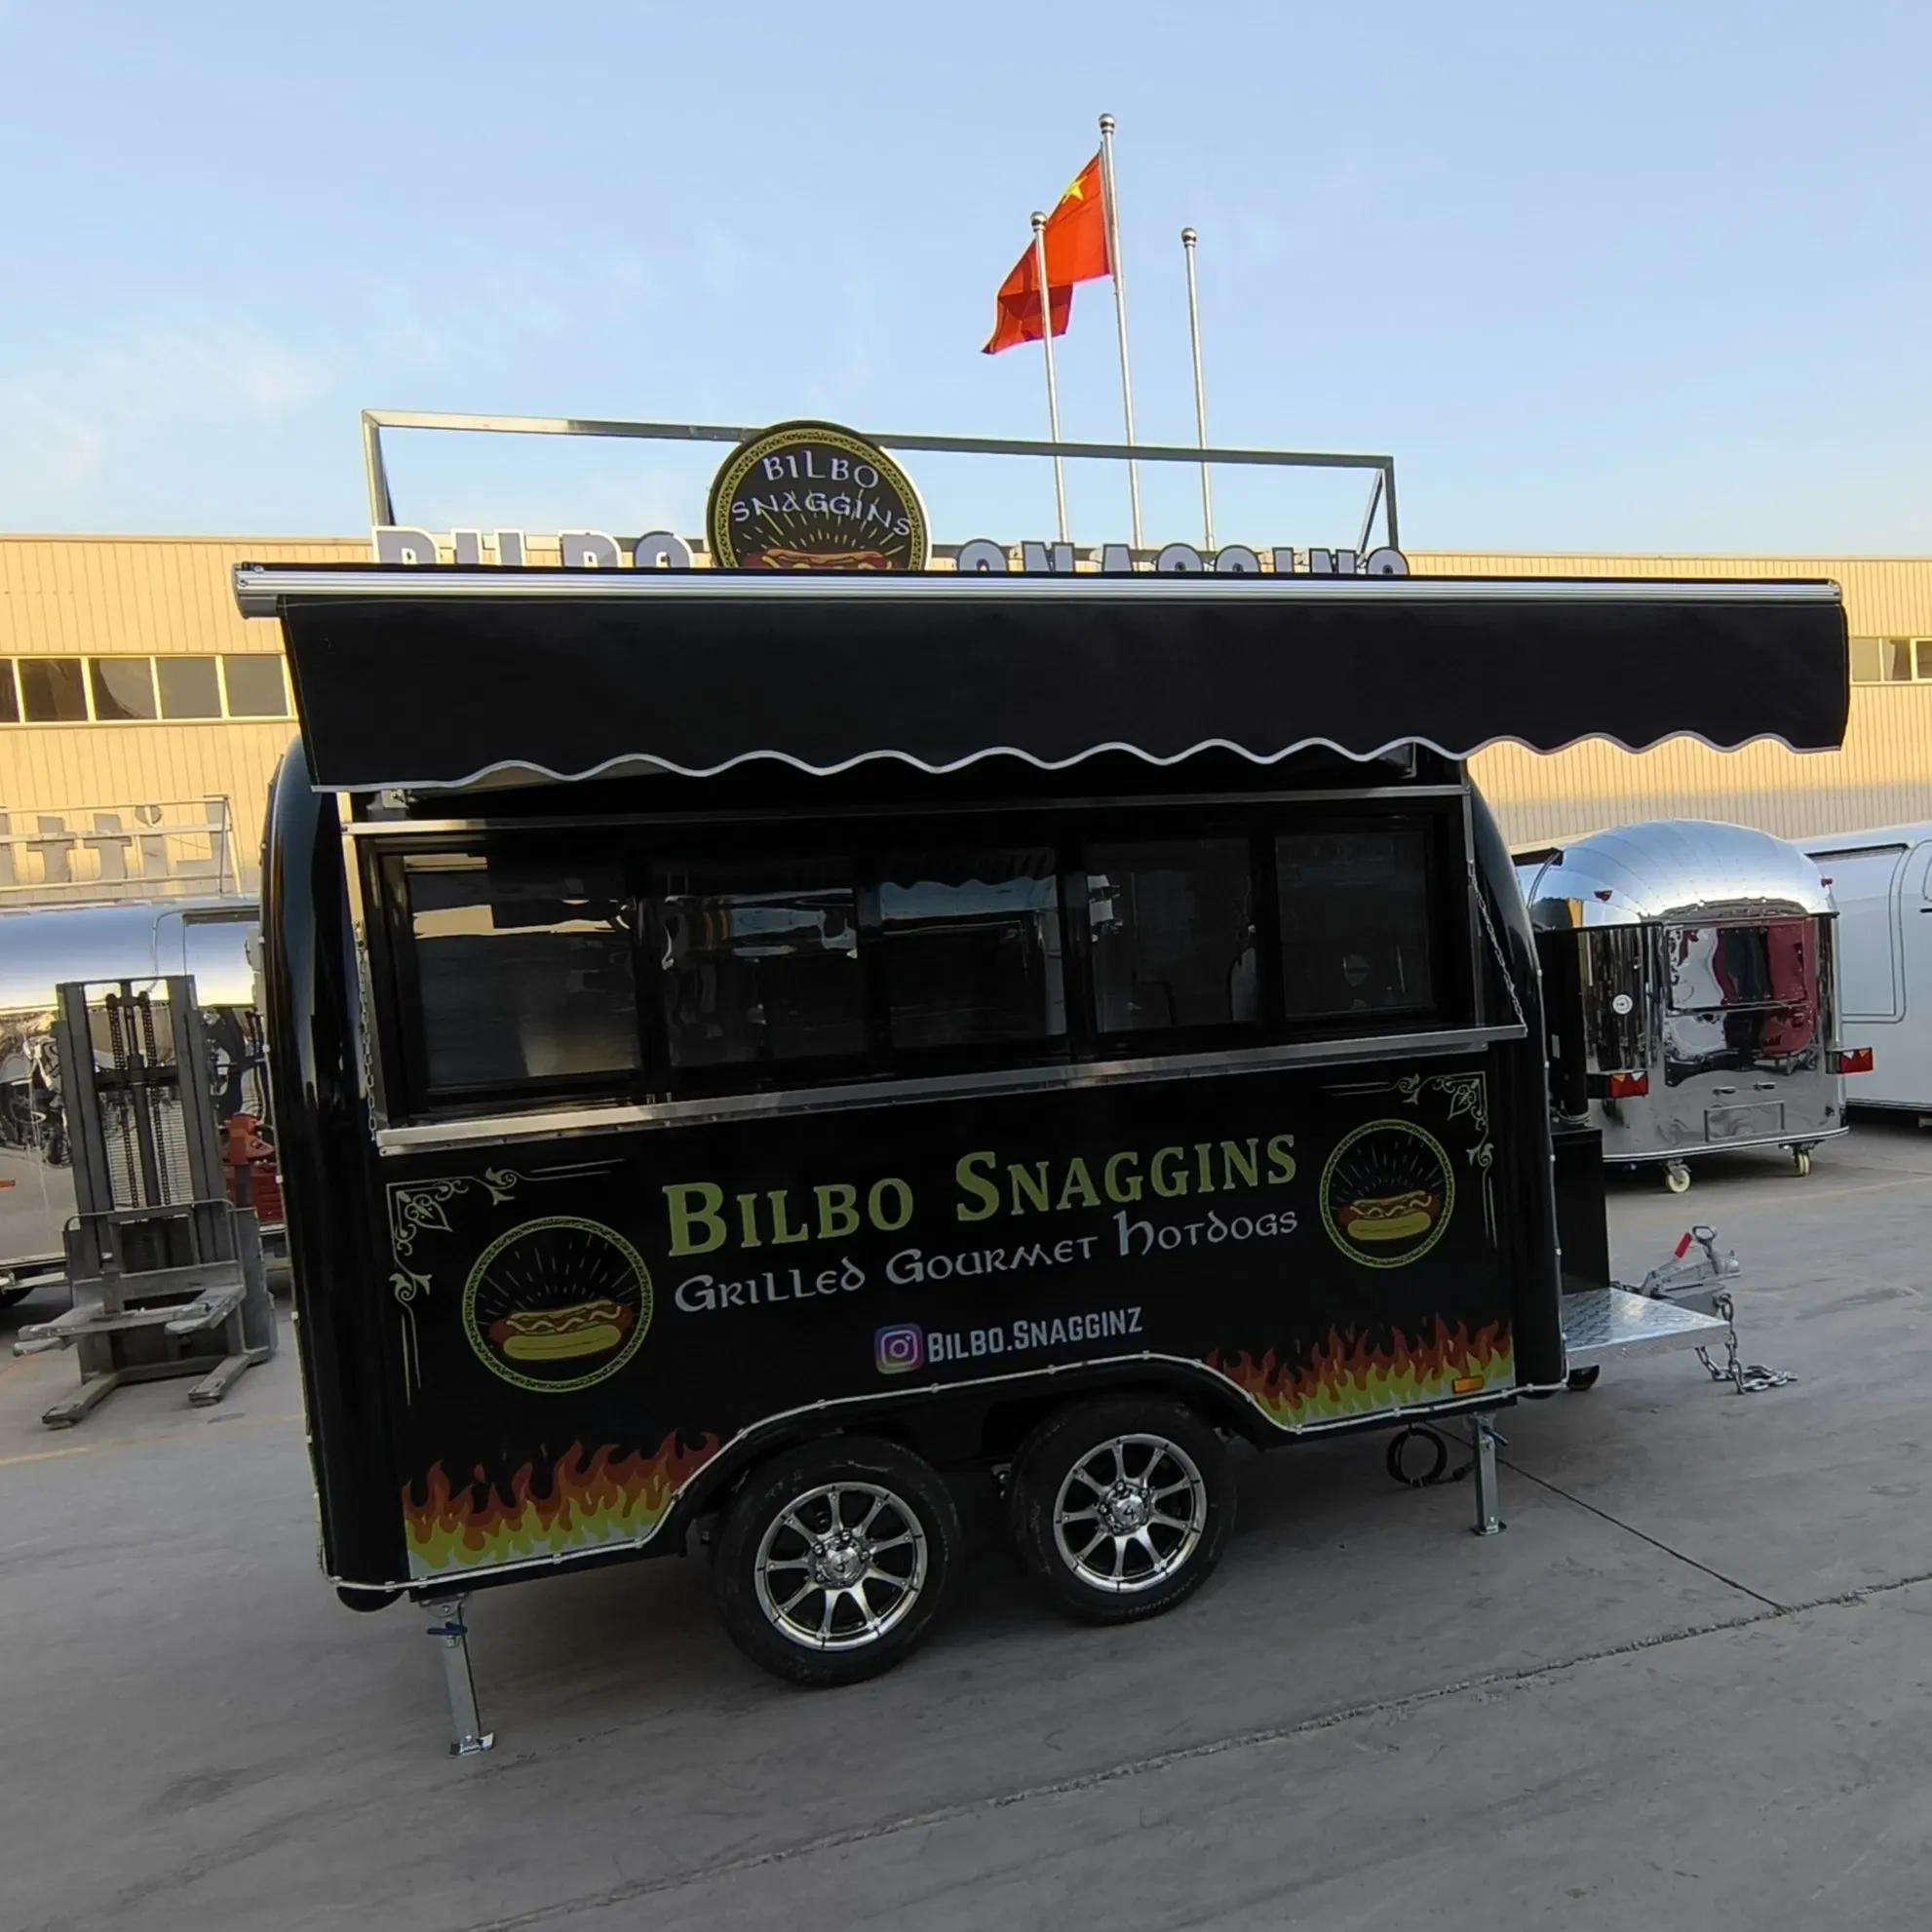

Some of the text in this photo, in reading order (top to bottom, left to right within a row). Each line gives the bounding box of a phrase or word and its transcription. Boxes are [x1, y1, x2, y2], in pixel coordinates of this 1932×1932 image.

[761, 449, 879, 489] BILBO
[731, 491, 911, 537] SNAGGINS
[662, 1134, 1297, 1257] BILBO SNAGGINS
